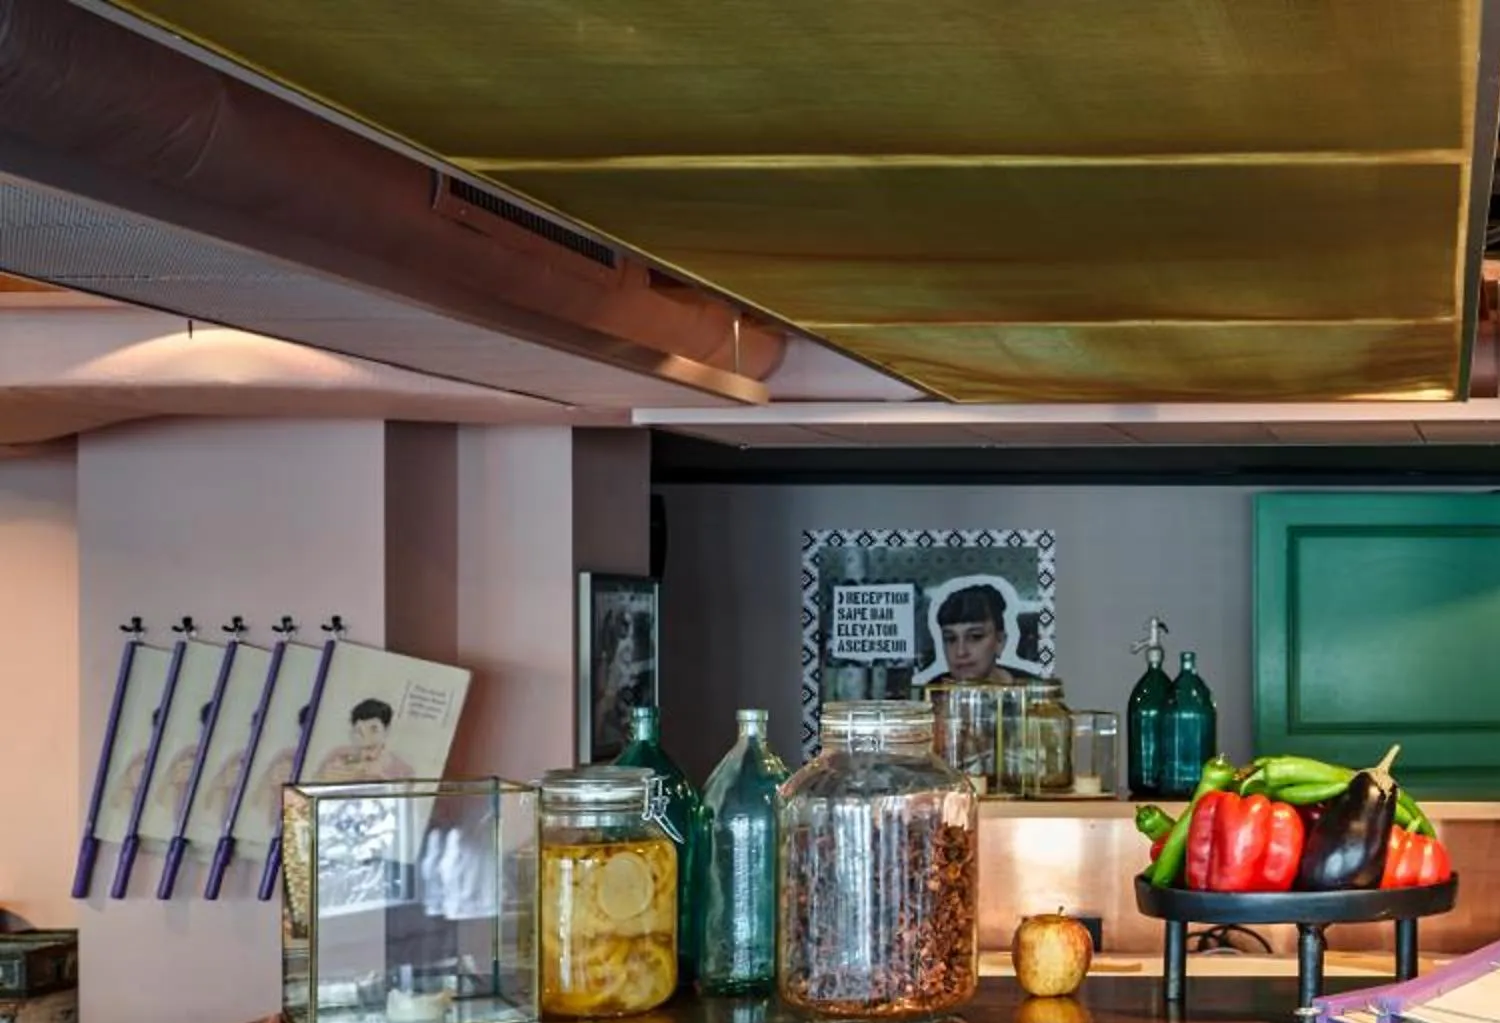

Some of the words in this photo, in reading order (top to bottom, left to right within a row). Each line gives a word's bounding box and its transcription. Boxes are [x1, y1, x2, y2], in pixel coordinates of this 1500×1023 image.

[845, 591, 910, 605] RECEPTION
[837, 623, 898, 637] ELEVATOR
[837, 639, 907, 653] ASCENSEUR
